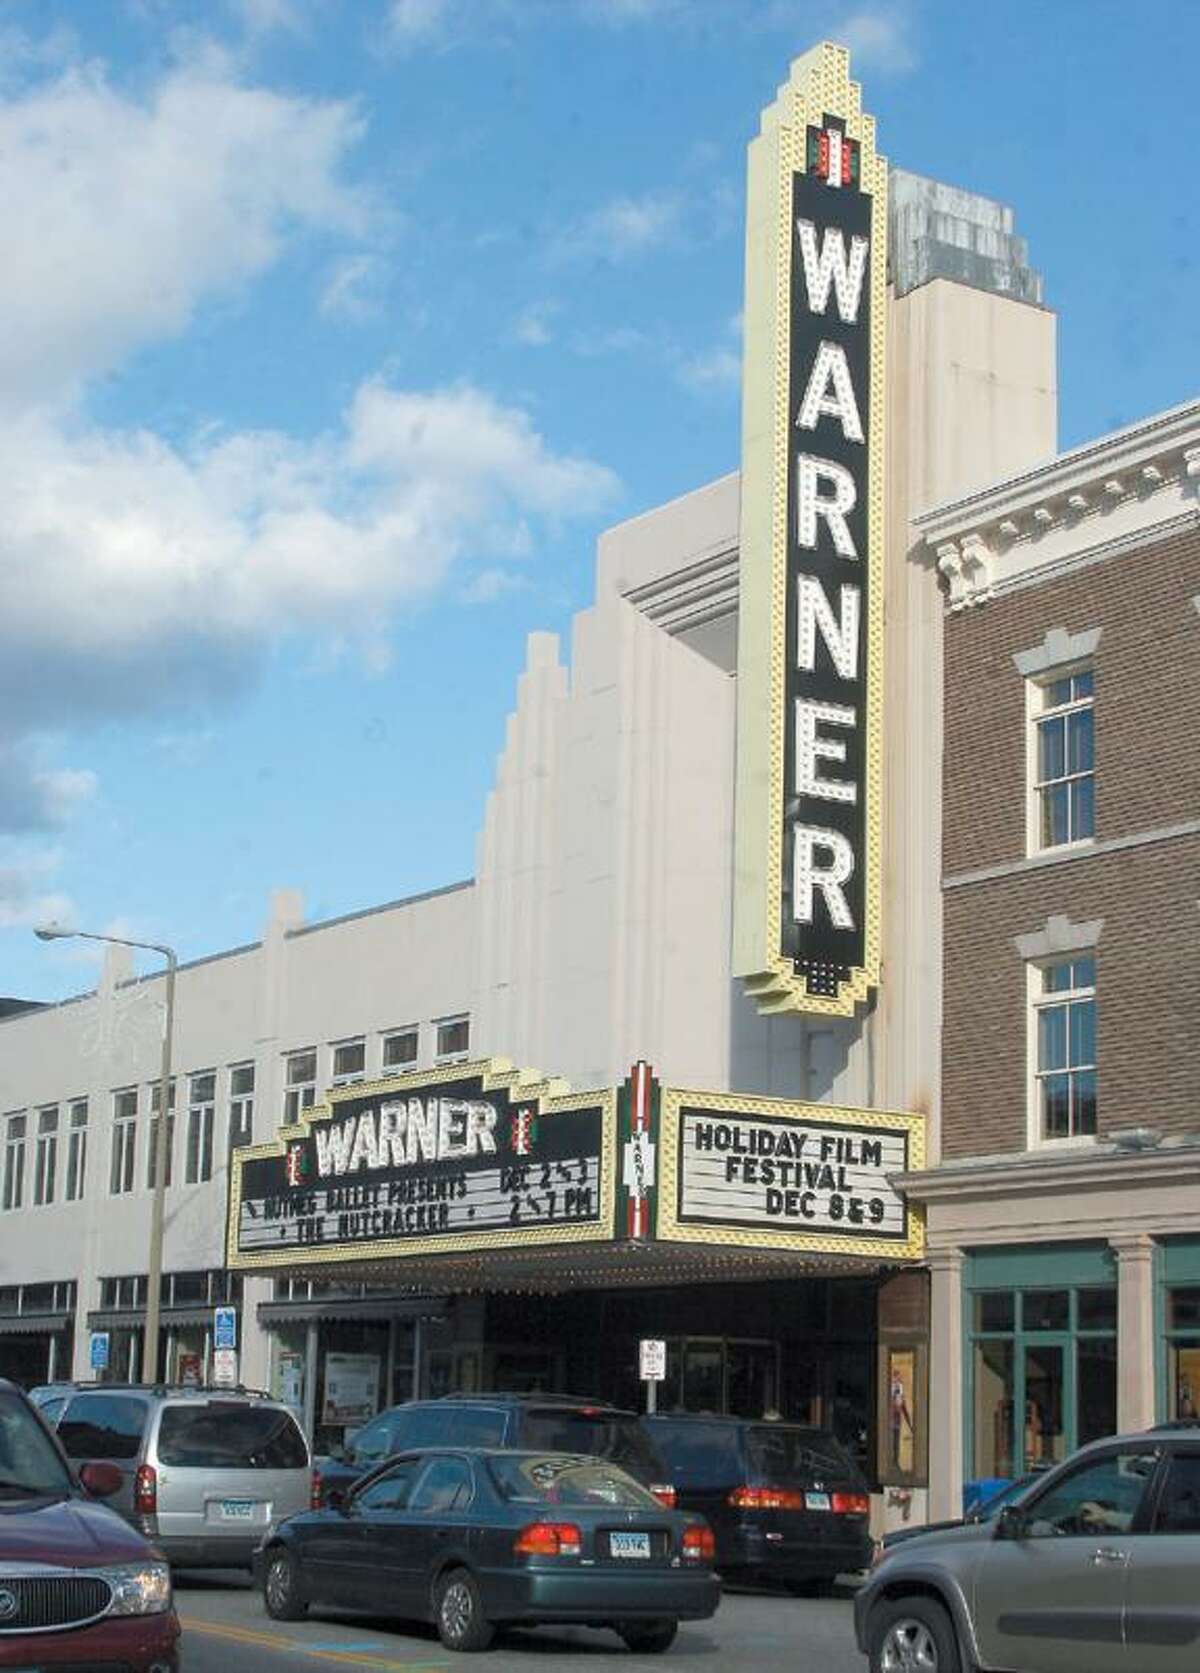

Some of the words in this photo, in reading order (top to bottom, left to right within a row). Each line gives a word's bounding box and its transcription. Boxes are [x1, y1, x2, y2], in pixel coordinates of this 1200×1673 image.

[794, 217, 869, 933] WARNER
[315, 1097, 497, 1177] WARNER
[695, 1122, 809, 1159] HOLIDAY
[820, 1135, 882, 1167] FILM
[725, 1155, 852, 1193] FESTIVAL
[565, 1187, 593, 1215] PM
[765, 1187, 816, 1218] DEC
[297, 1215, 325, 1243] THE
[338, 1203, 449, 1239] NUTCRACKER
